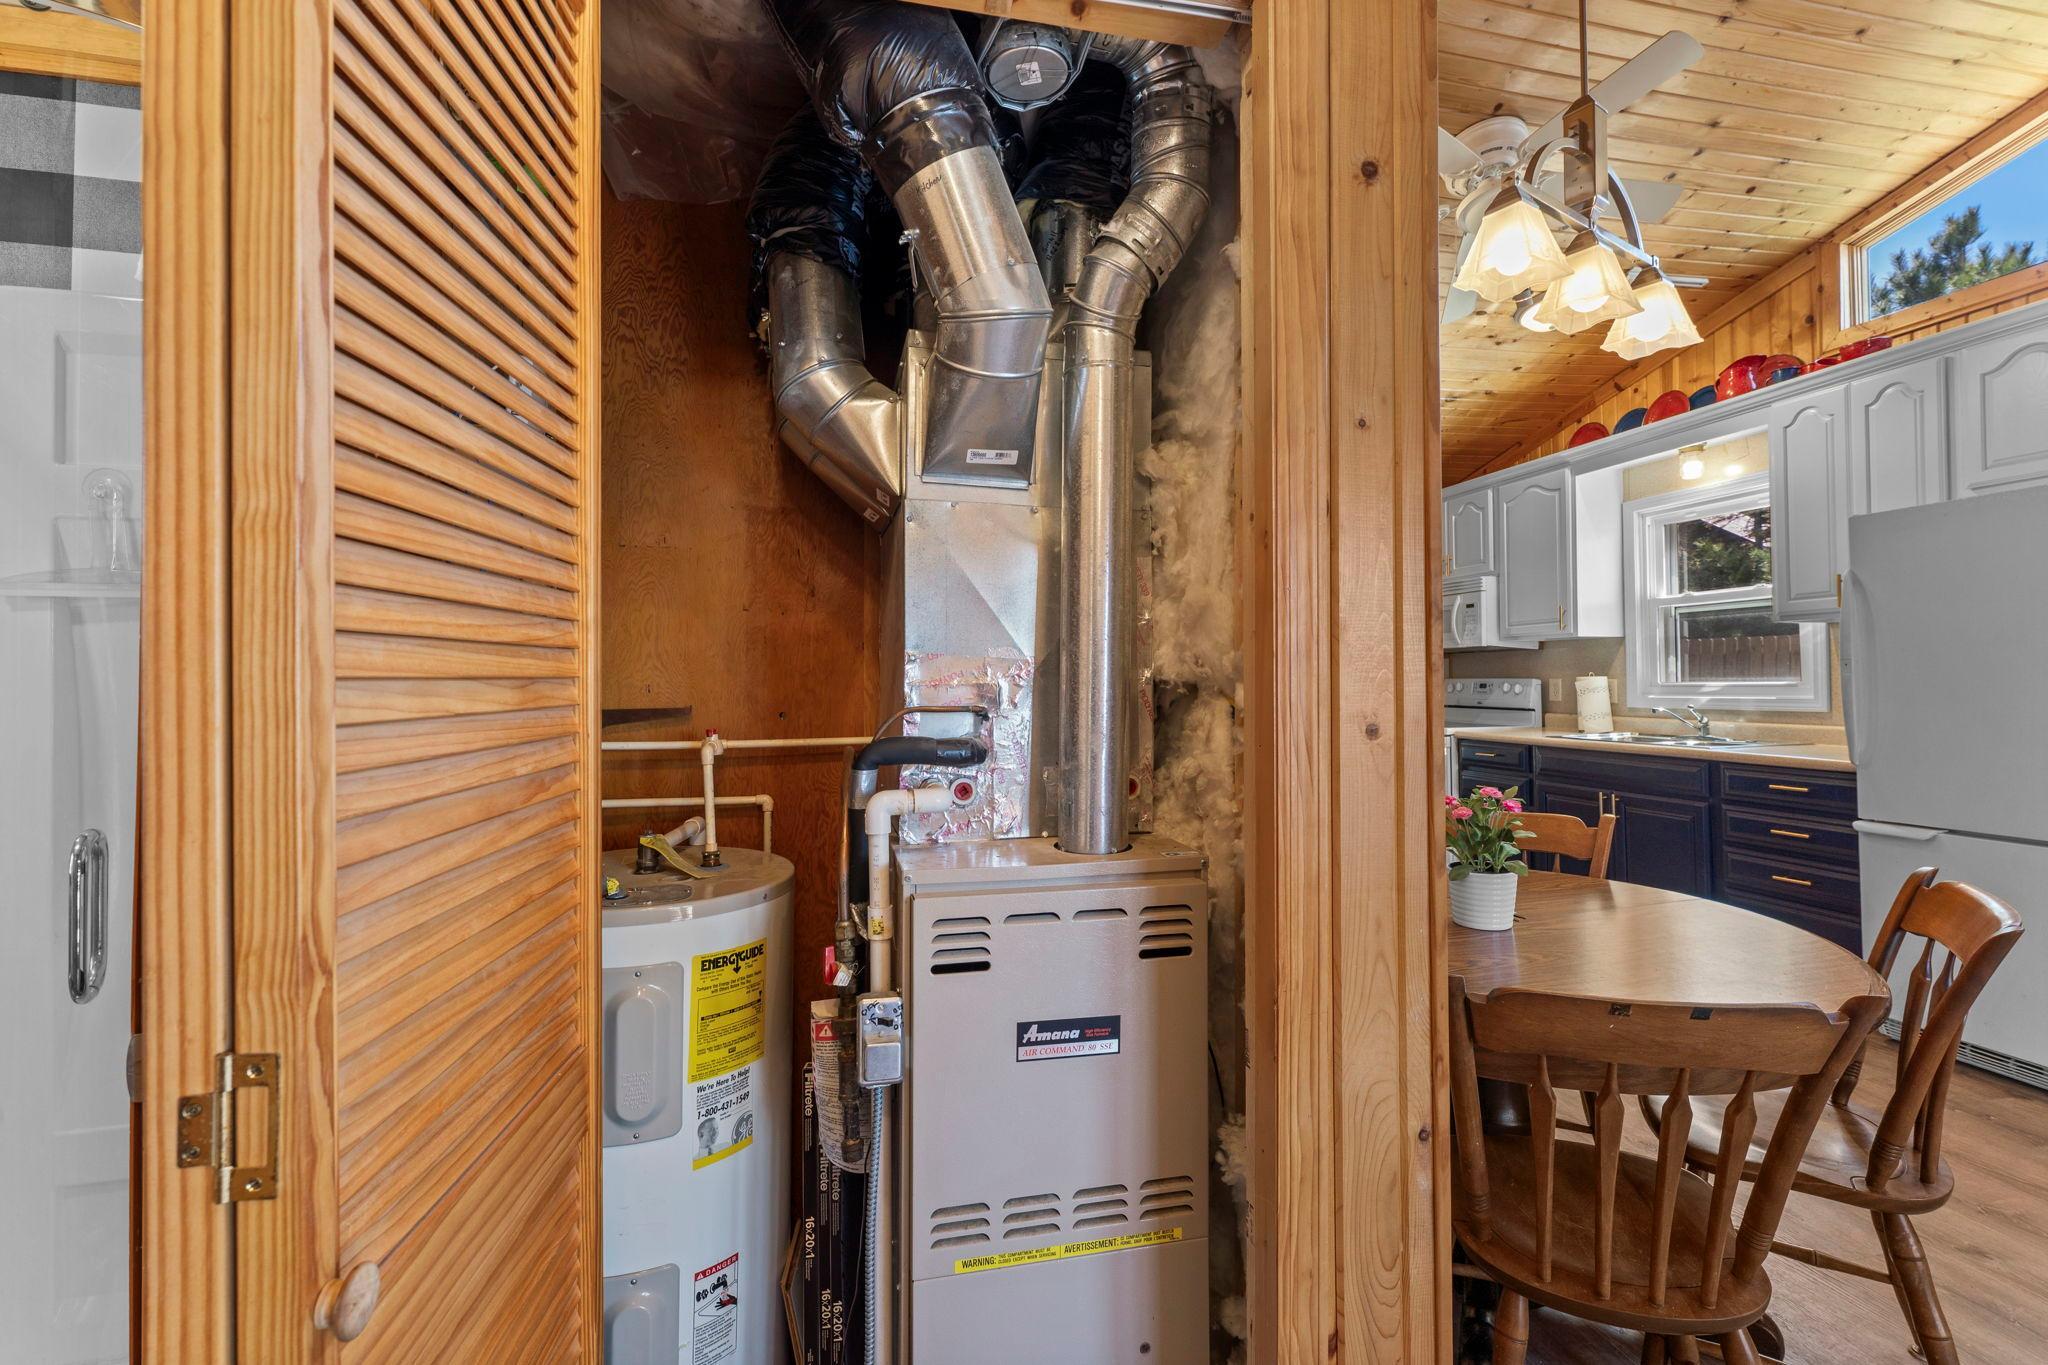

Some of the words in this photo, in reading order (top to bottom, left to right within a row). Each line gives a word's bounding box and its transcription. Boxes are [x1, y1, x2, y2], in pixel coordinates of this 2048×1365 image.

[700, 944, 765, 973] ENERGYGUIDE
[1022, 1024, 1080, 1044] Amana
[1023, 1048, 1038, 1057] AIR
[1039, 1045, 1085, 1055] COMMAND
[697, 1083, 715, 1093] We're
[716, 1079, 730, 1087] Here
[731, 1073, 737, 1081] To
[804, 1073, 814, 1117] Filtrete
[832, 1165, 841, 1201] iltrete
[805, 1216, 815, 1259] 16x20x1
[1064, 1238, 1119, 1254] AVERTISSEMENT:
[706, 1256, 738, 1276] DANGER
[961, 1256, 997, 1269] WARNING:
[821, 1288, 831, 1329] 16x20x1
[833, 1300, 843, 1342] 16x20x1
